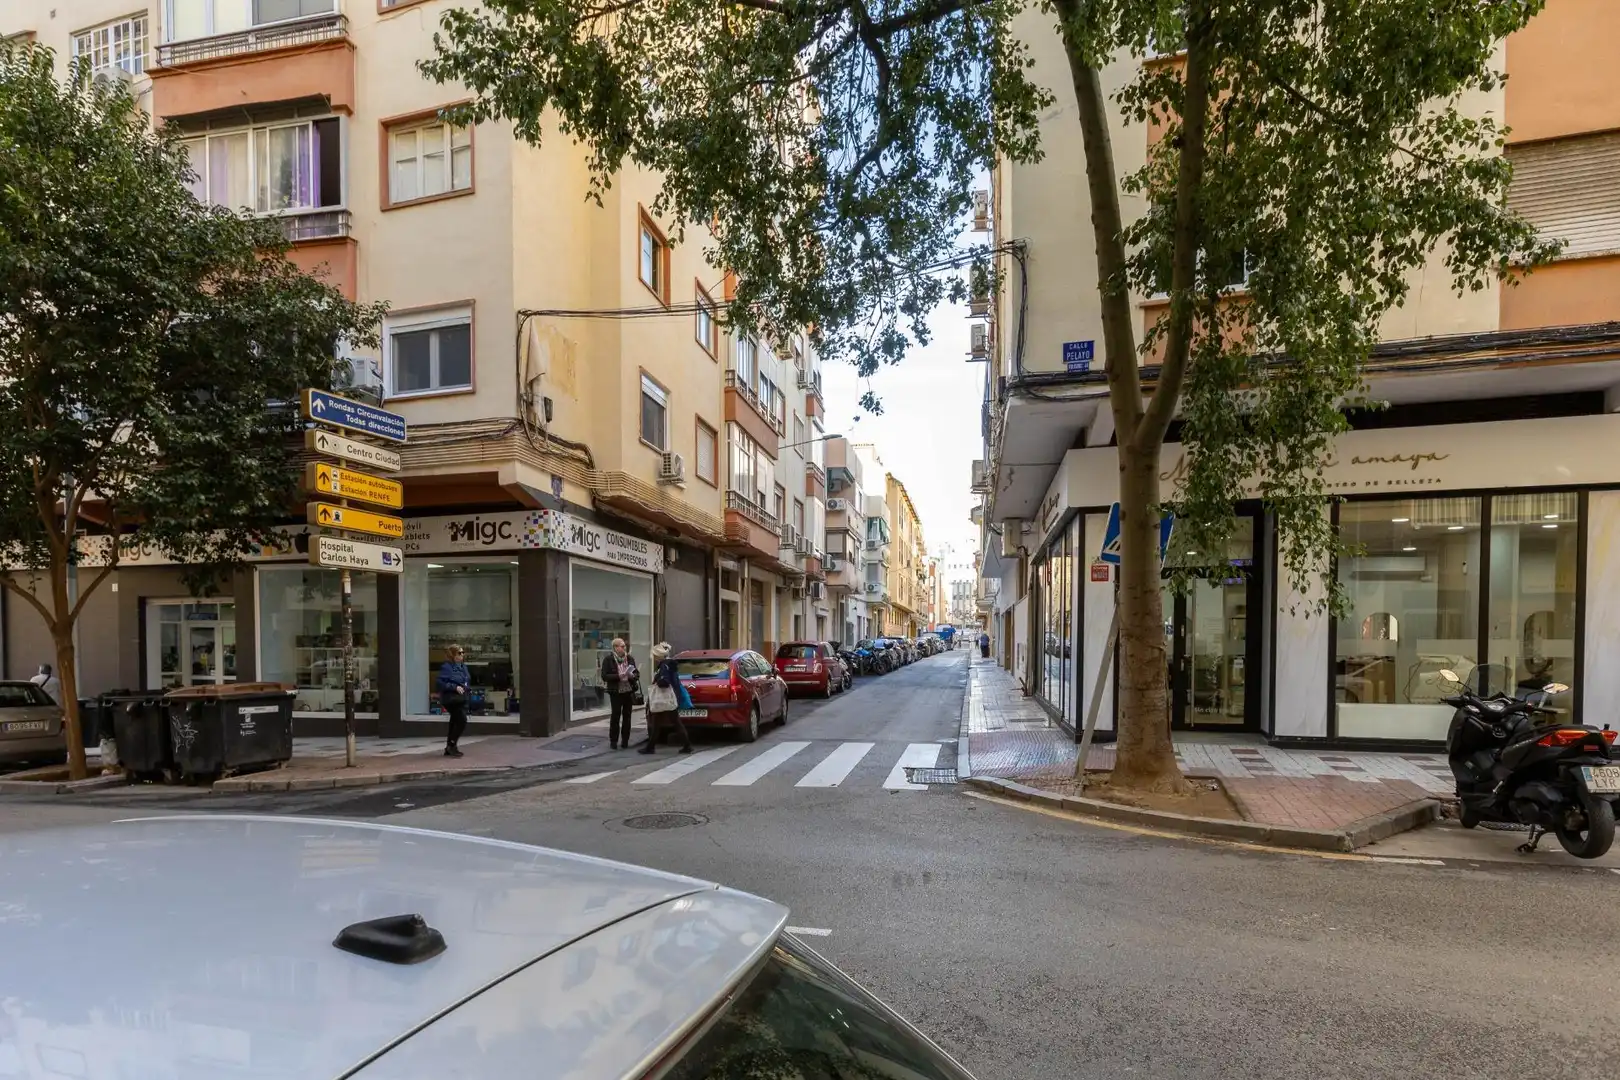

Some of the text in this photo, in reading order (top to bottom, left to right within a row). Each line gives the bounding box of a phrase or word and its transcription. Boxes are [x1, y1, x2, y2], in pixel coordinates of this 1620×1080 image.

[1066, 350, 1090, 361] PELAYO
[328, 399, 405, 428] Rondas Circunvalación
[345, 413, 405, 437] Todas direcciones
[346, 444, 400, 466] Centro Ciudad
[1351, 452, 1453, 471] amaya
[340, 472, 367, 485] Estación
[1365, 479, 1379, 487] DE
[1387, 477, 1442, 486] BELLEZA
[368, 490, 391, 502] RENFE
[378, 520, 402, 533] Puerto
[404, 520, 421, 531] óvil
[448, 516, 512, 545] Migc
[570, 523, 600, 552] Migc
[606, 532, 648, 554] CONSUMIBLES
[320, 540, 354, 554] Hospital
[320, 551, 369, 566] Carlos Haya
[617, 551, 648, 567] IMPRESORAS
[1592, 767, 1619, 778] 4608
